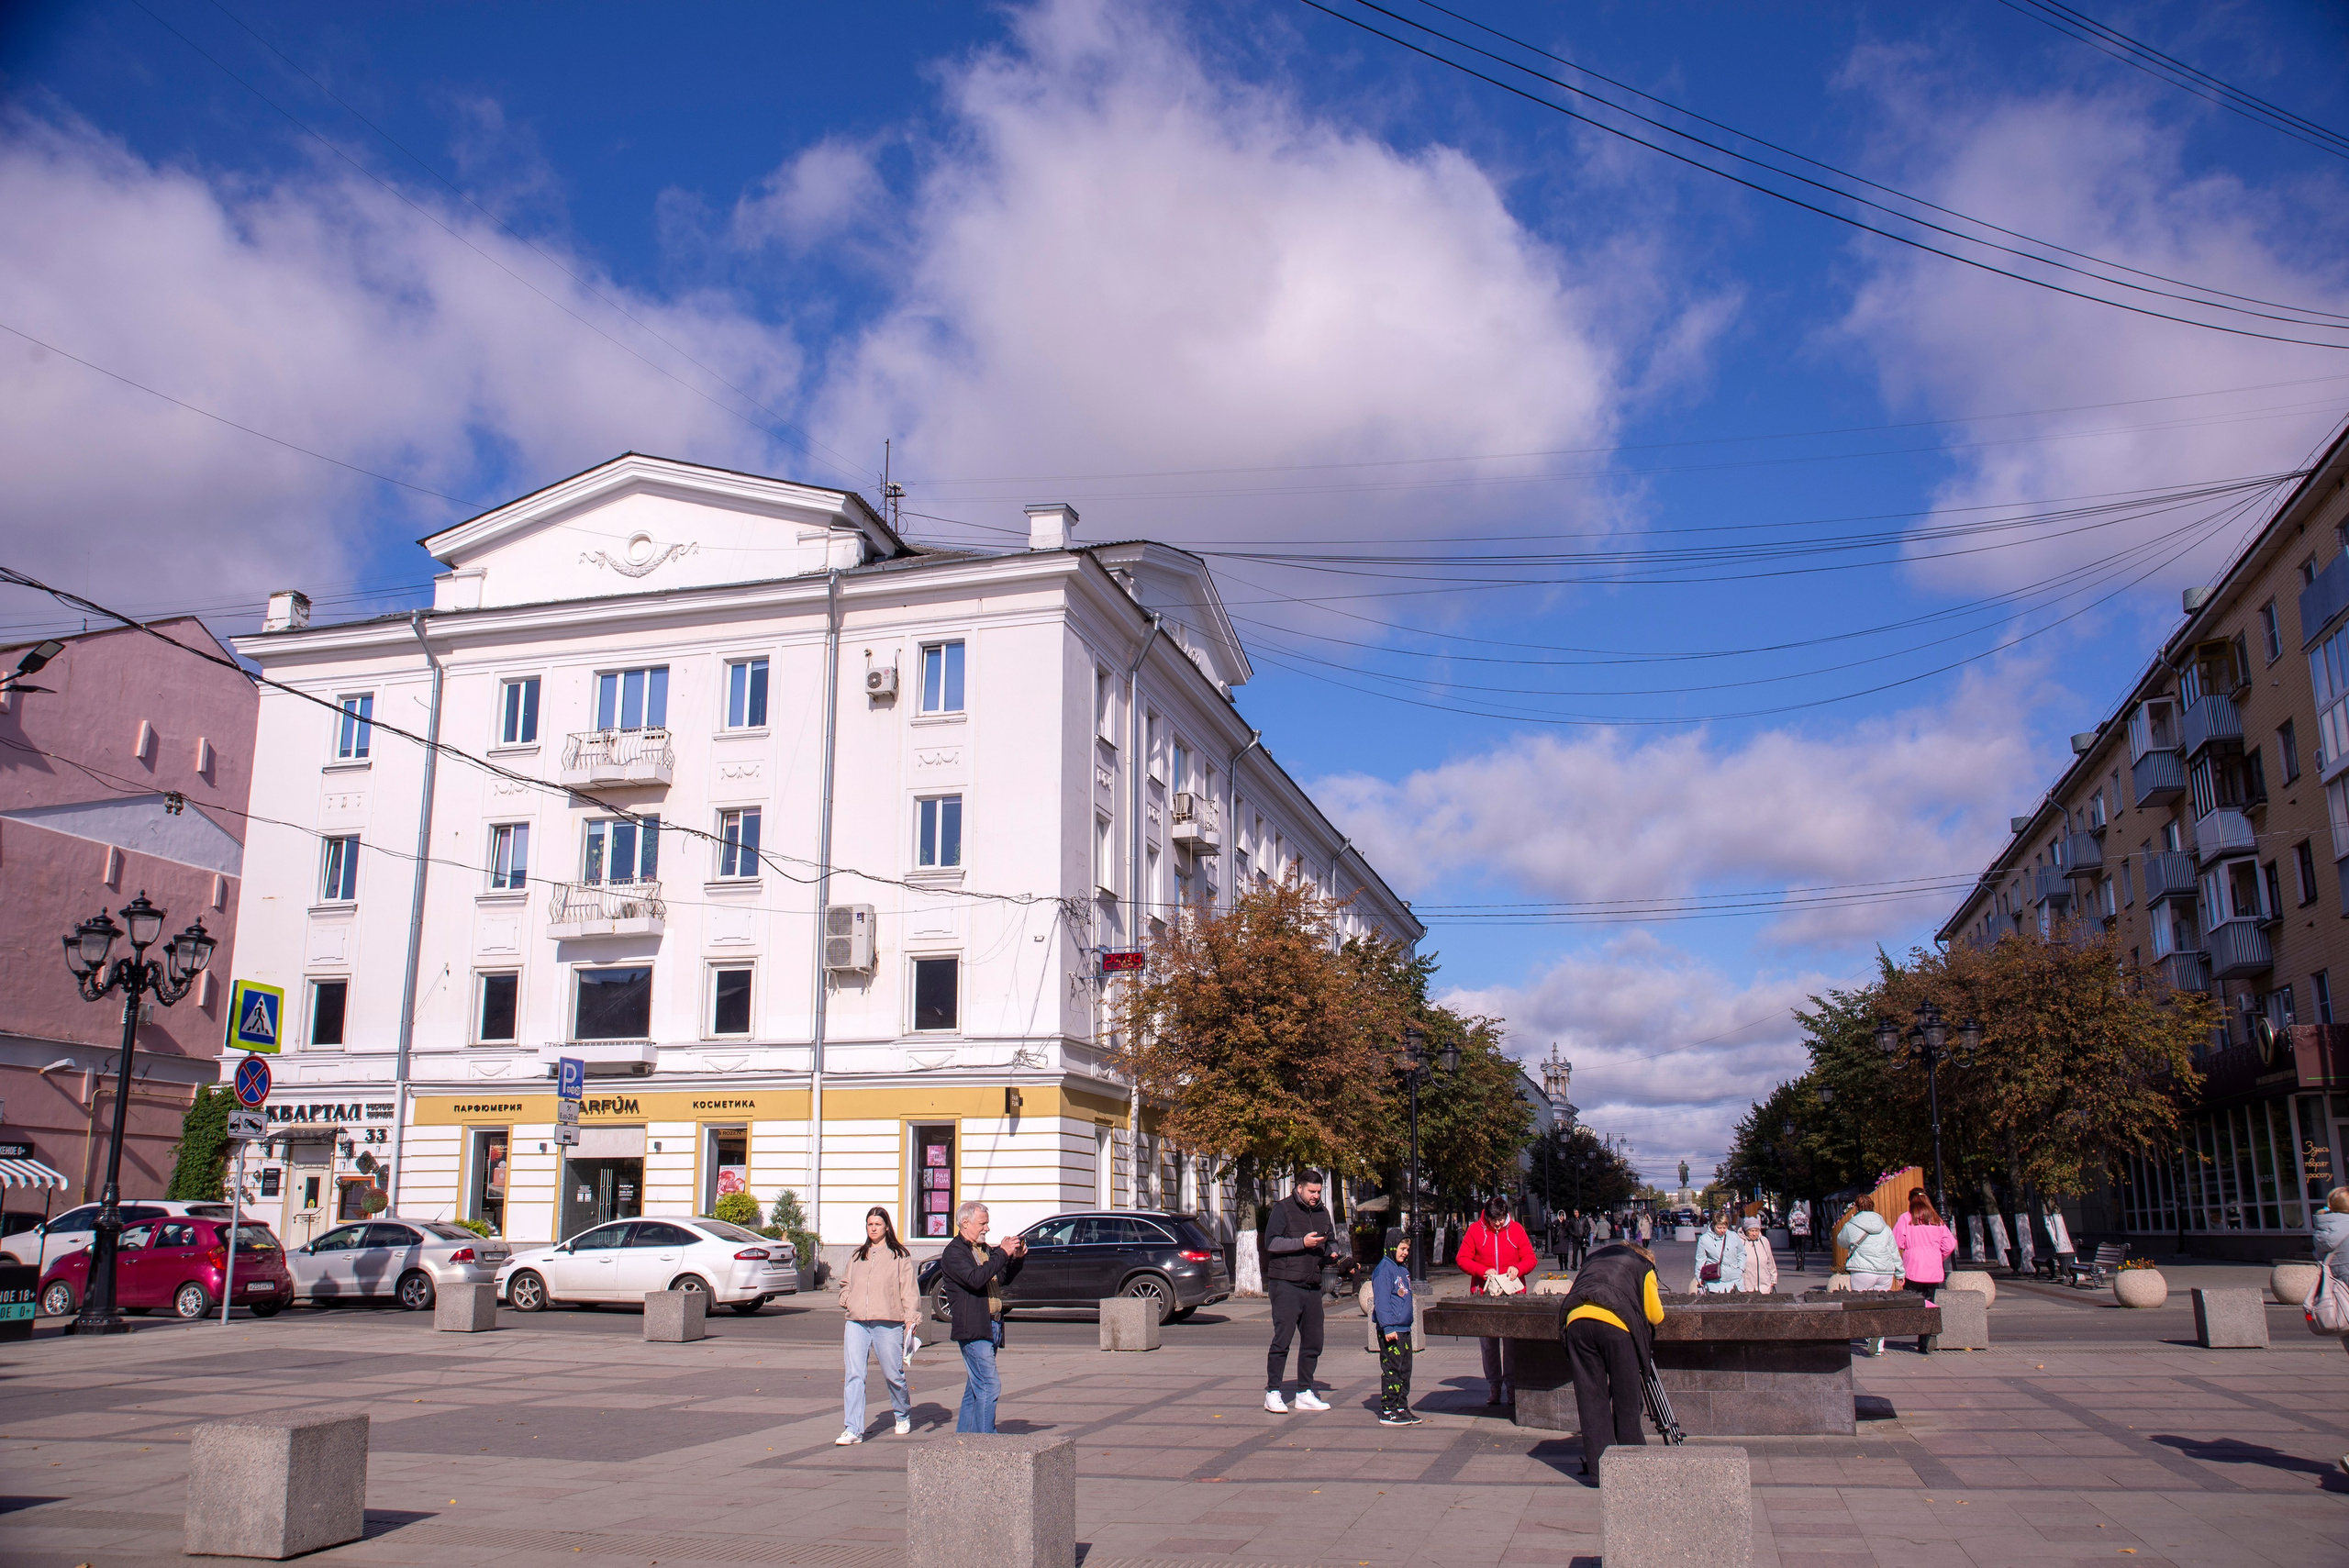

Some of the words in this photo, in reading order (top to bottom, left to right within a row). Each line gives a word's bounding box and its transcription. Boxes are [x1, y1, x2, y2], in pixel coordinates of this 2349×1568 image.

[453, 1104, 523, 1113] ПАРФЮМЕРИЯ
[693, 1100, 755, 1109] КОСМЕТИКА
[266, 1104, 362, 1122] КВАРТАЛ
[365, 1129, 387, 1143] 33
